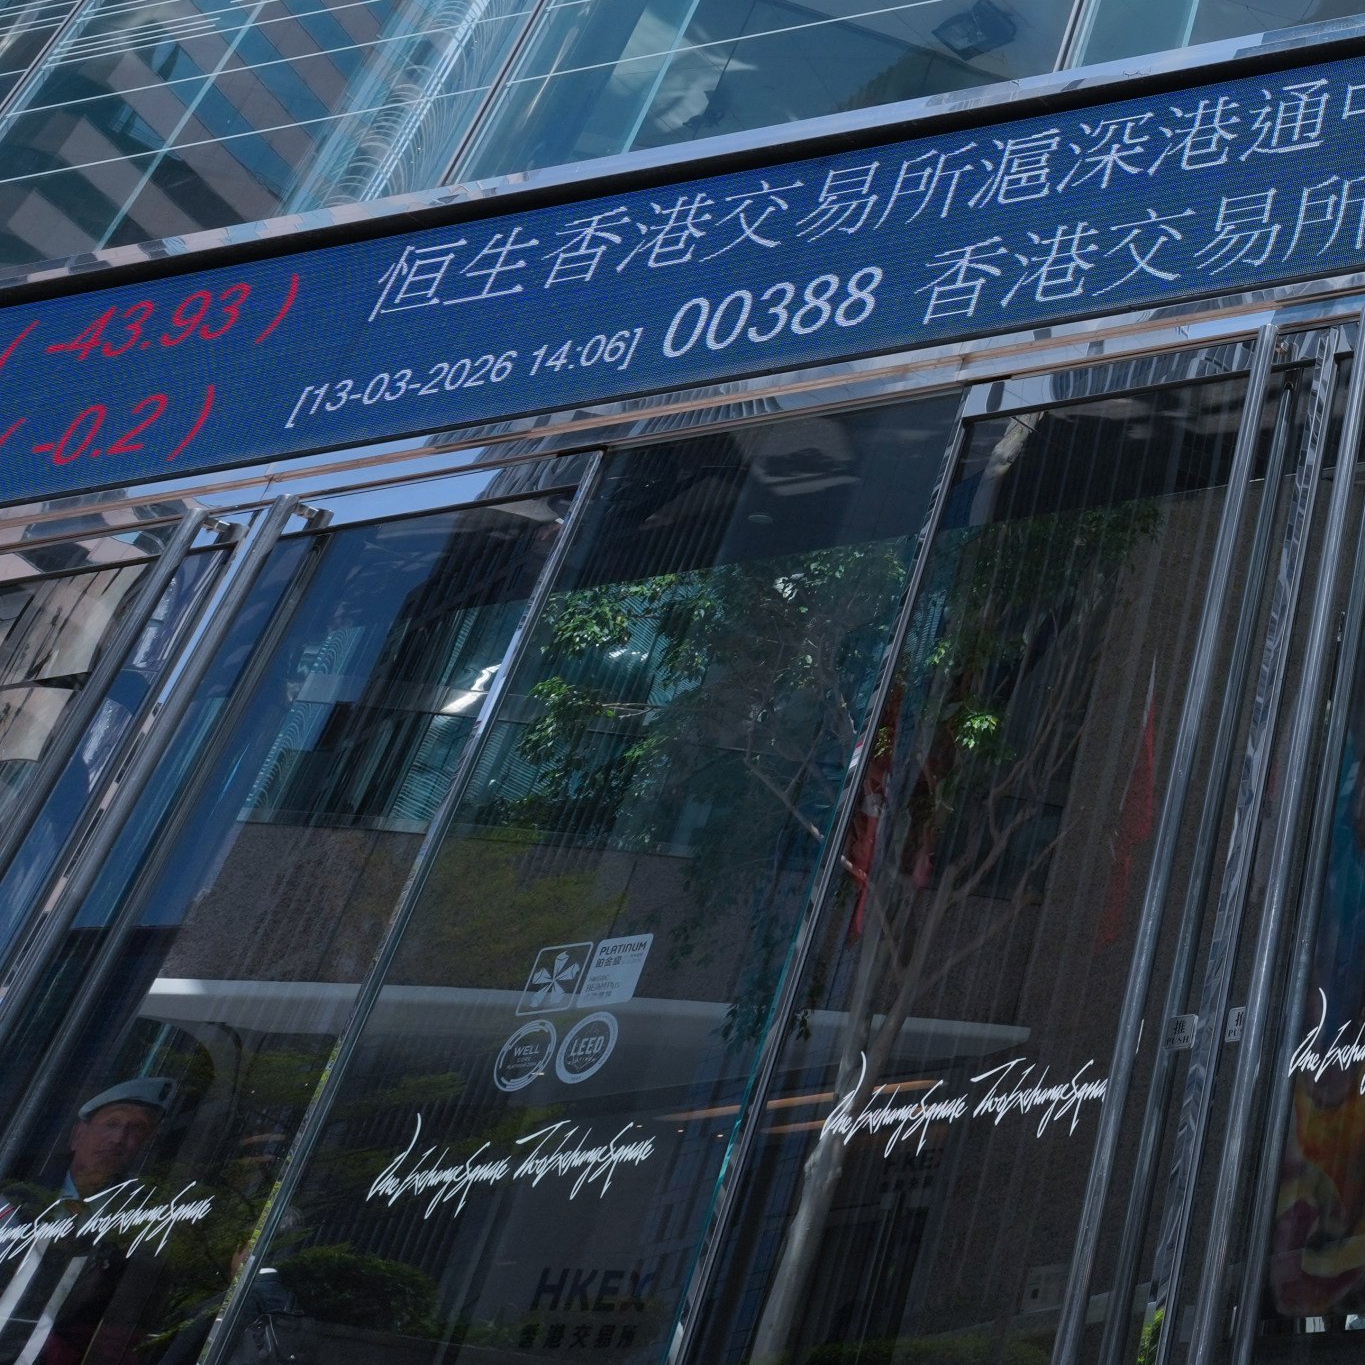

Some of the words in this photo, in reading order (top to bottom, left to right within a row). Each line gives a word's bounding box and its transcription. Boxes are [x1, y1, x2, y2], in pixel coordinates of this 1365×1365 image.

[284, 350, 518, 428] [13-03-2026
[661, 266, 884, 359] 00388
[599, 941, 647, 956] PLATINUM
[513, 1044, 539, 1056] WELL
[570, 1035, 605, 1056] LEED
[530, 1266, 656, 1312] HKEX
